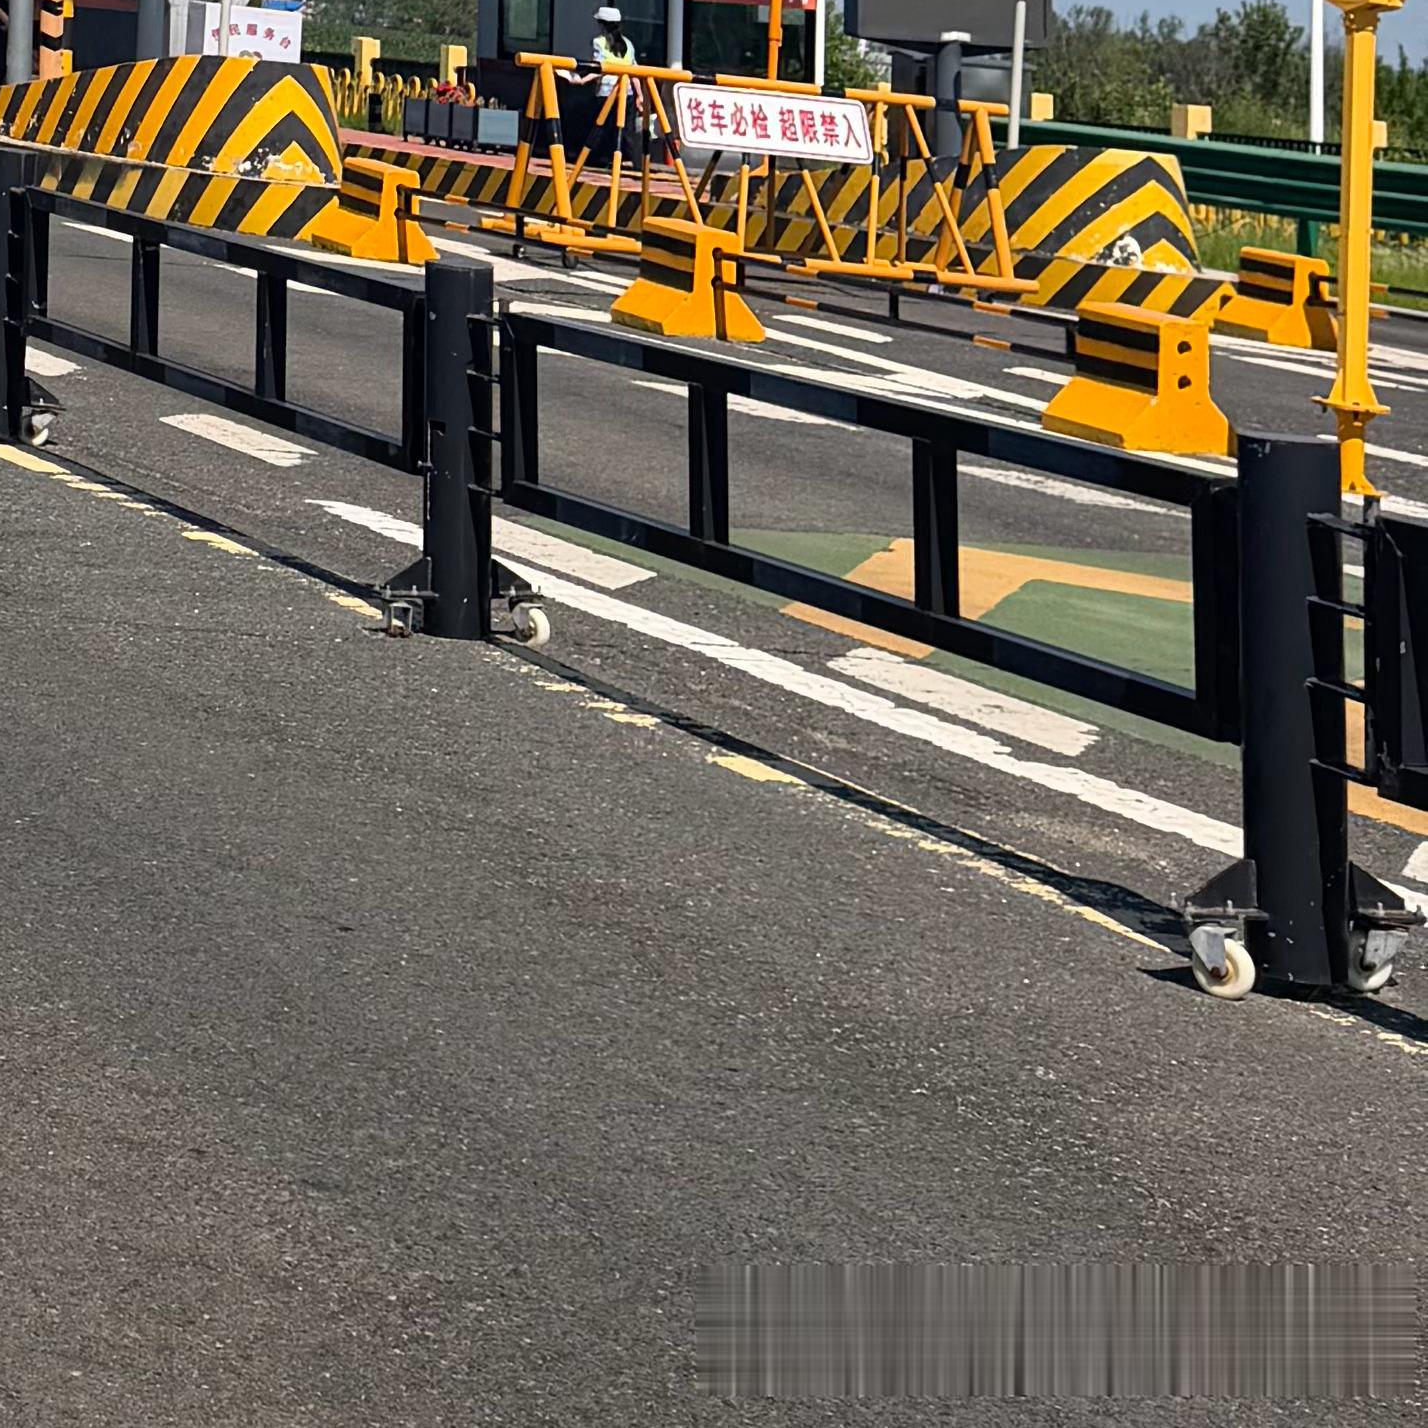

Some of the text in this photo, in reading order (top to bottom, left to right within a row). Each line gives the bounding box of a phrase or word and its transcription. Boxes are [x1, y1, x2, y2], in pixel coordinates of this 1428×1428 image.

[687, 98, 862, 148] 货车必检 超限禁入
